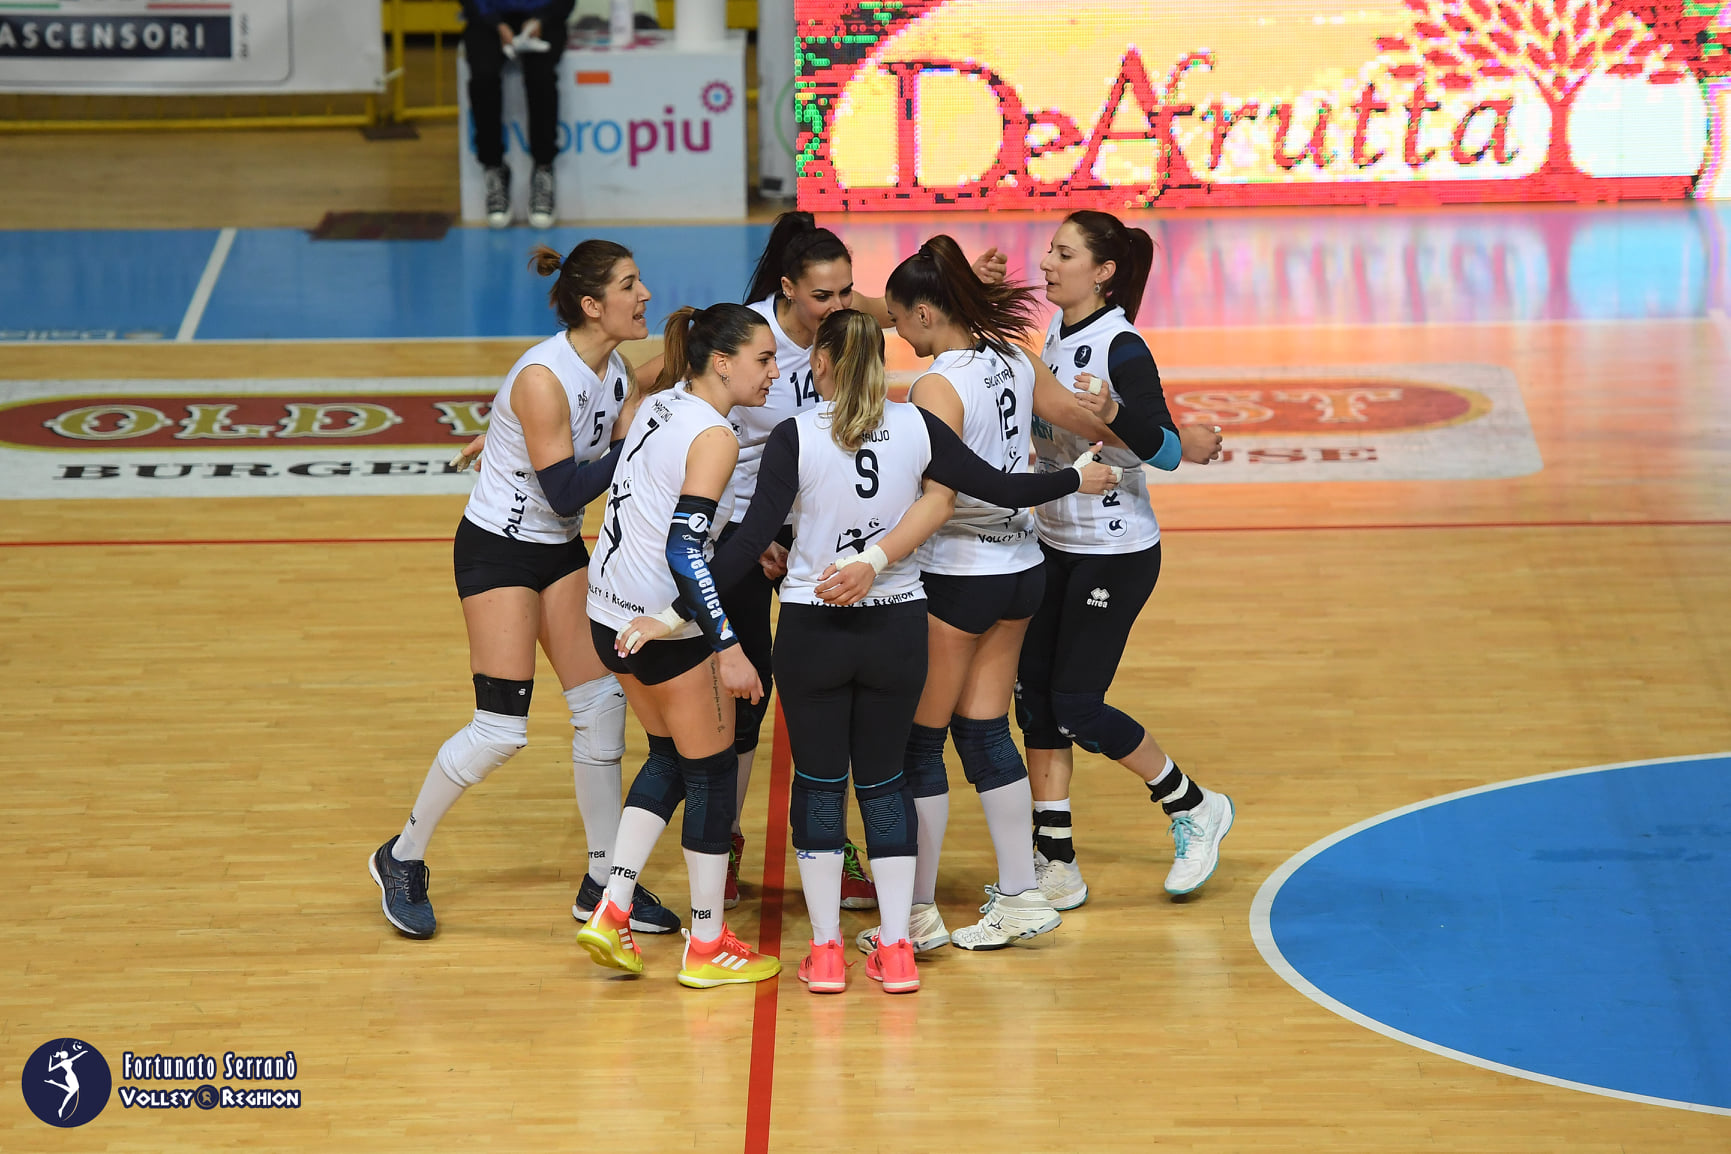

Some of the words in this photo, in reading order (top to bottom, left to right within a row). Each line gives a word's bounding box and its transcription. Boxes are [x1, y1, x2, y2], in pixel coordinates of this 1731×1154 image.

[0, 23, 205, 49] ASCENSORI
[790, 370, 819, 407] 14
[43, 402, 403, 441] OLD
[590, 411, 605, 447] 5
[995, 388, 1018, 441] 12
[627, 417, 660, 462] 7
[855, 449, 879, 498] 9
[695, 515, 706, 528] 7
[588, 850, 606, 859] rrea
[691, 908, 712, 920] rrea
